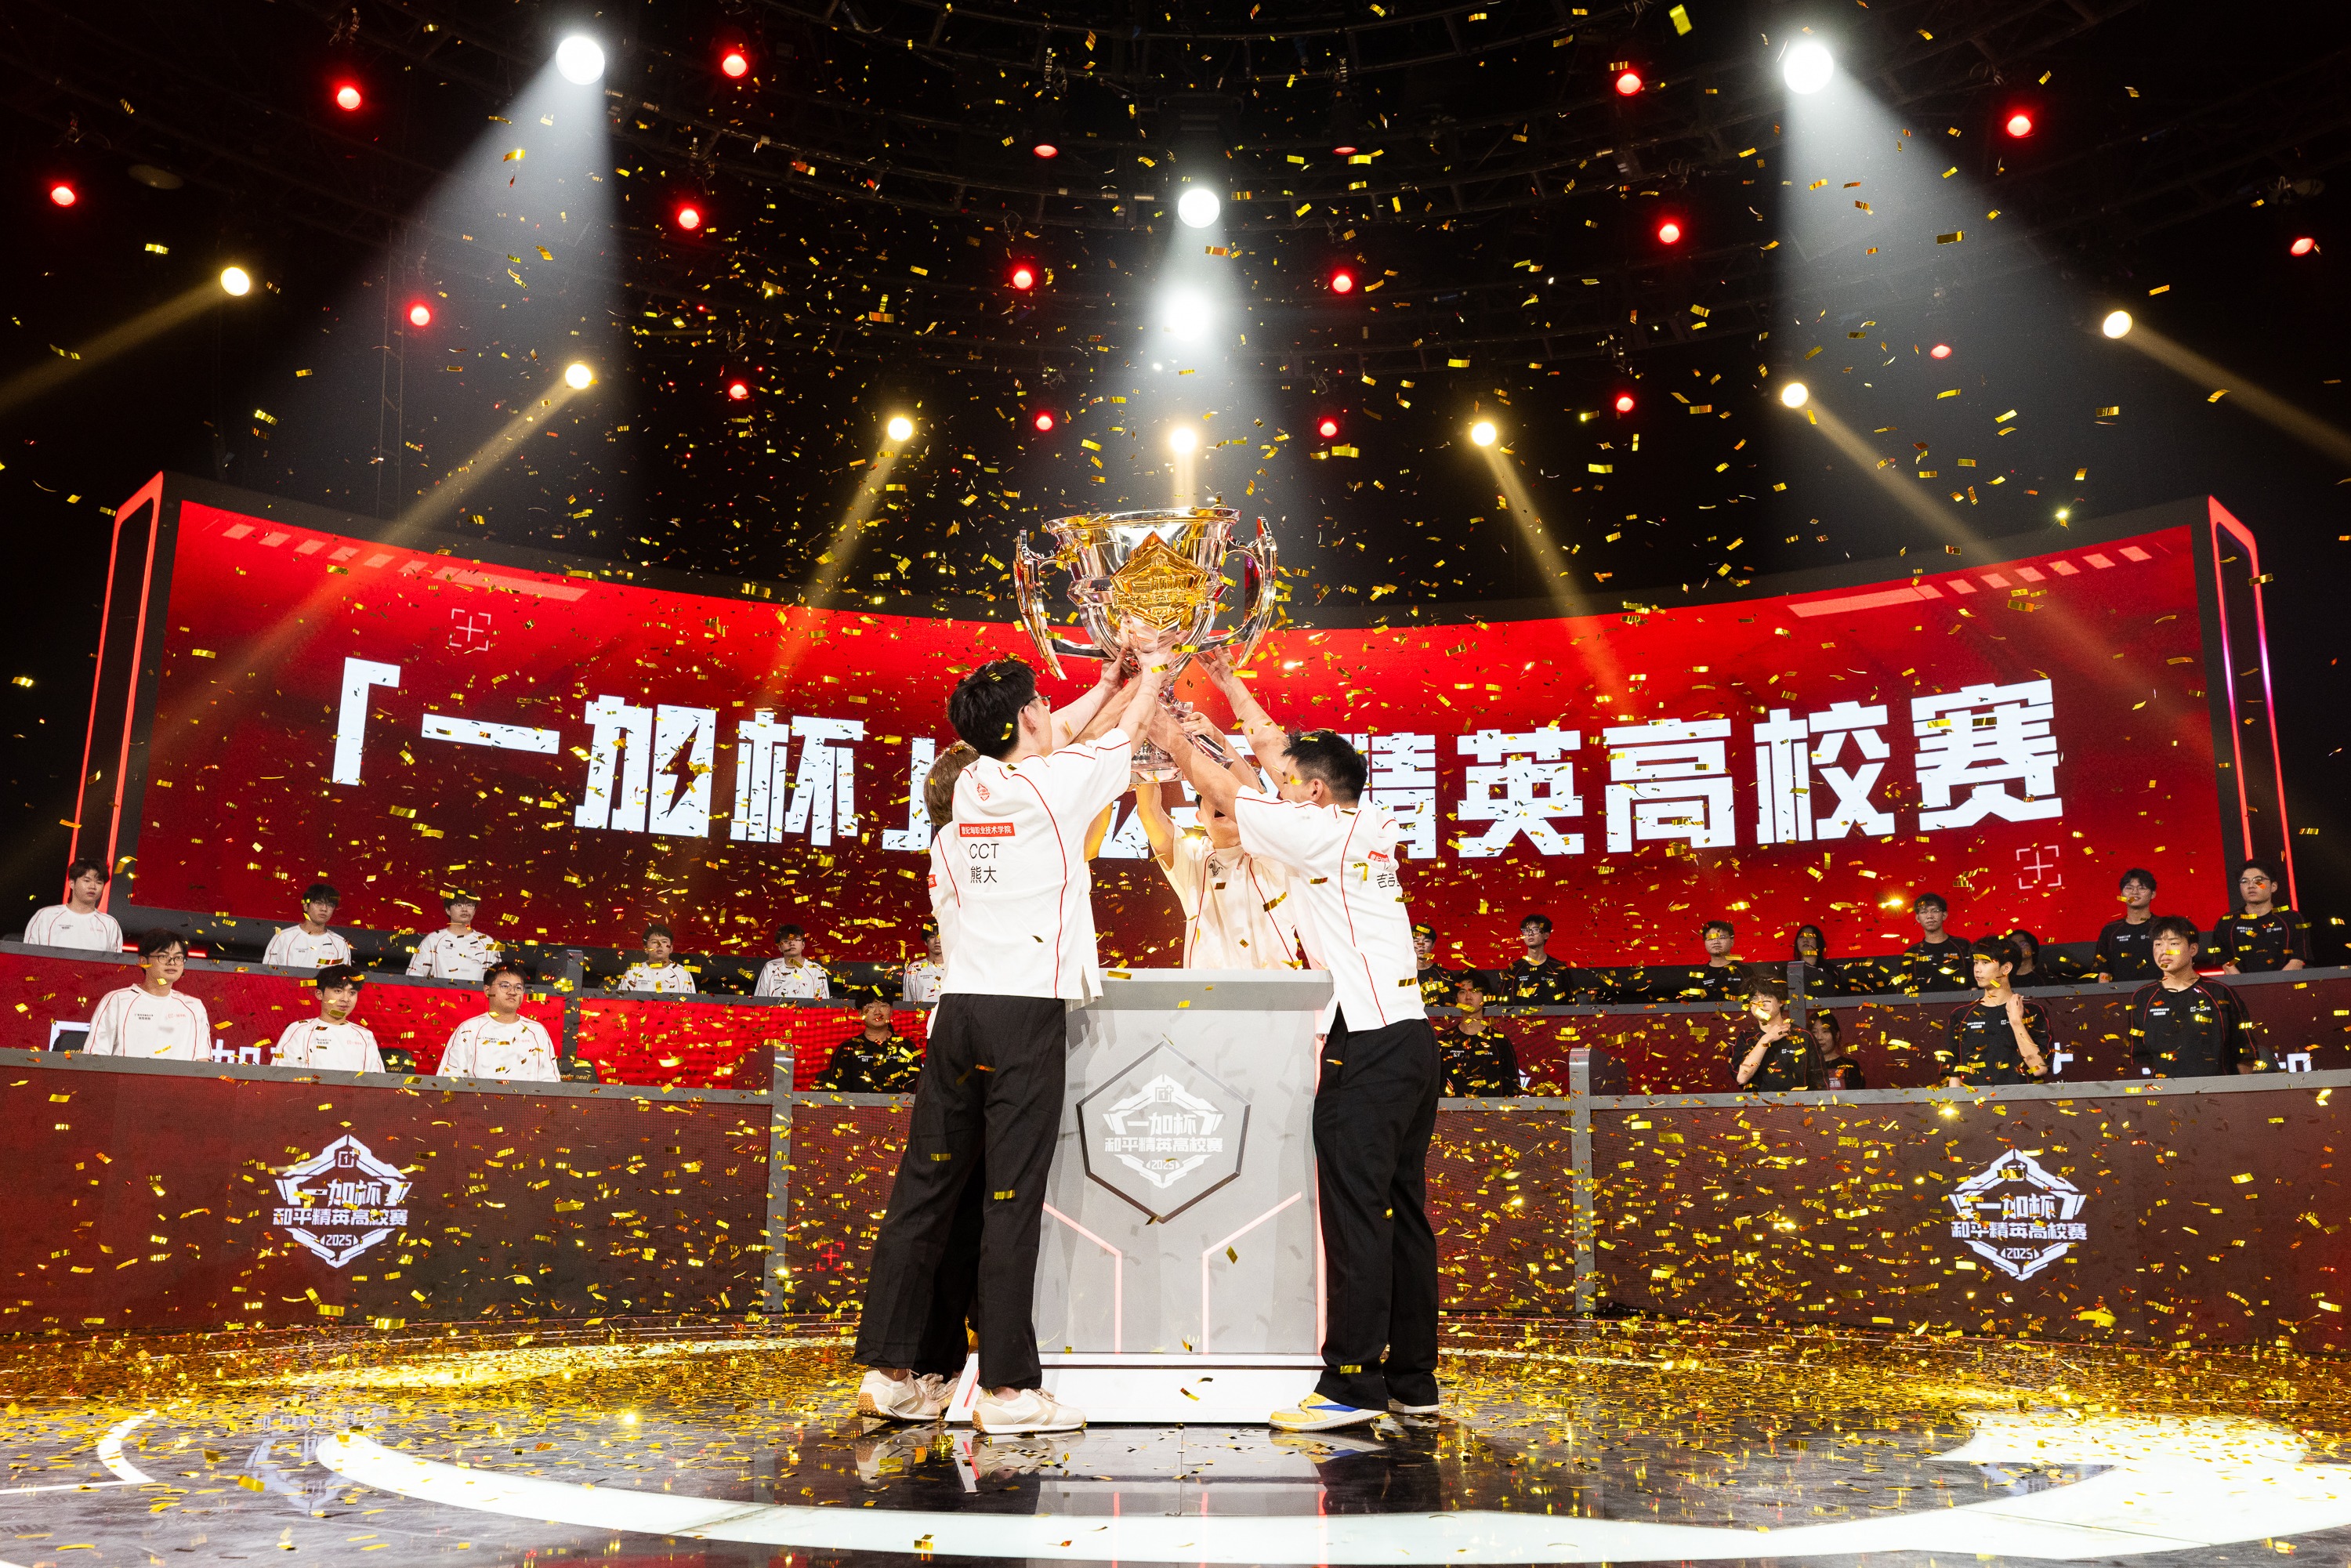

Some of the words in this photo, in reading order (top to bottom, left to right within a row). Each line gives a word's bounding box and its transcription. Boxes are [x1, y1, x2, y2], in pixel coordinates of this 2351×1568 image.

[332, 657, 2063, 859] 「一加杯」精英高校赛
[969, 843, 999, 859] CCT
[970, 866, 998, 883] 熊大
[1127, 1112, 1197, 1136] 一加杯
[1104, 1137, 1223, 1153] 和平精英高校赛
[1151, 1159, 1175, 1170] 2025
[302, 1179, 382, 1207] 一加杯
[1976, 1193, 2056, 1221] 一加杯
[273, 1208, 408, 1226] 和平精英高校赛
[1951, 1221, 2088, 1240] 和平精英高校赛
[325, 1234, 353, 1246] 2025
[2007, 1248, 2034, 1260] 2025
